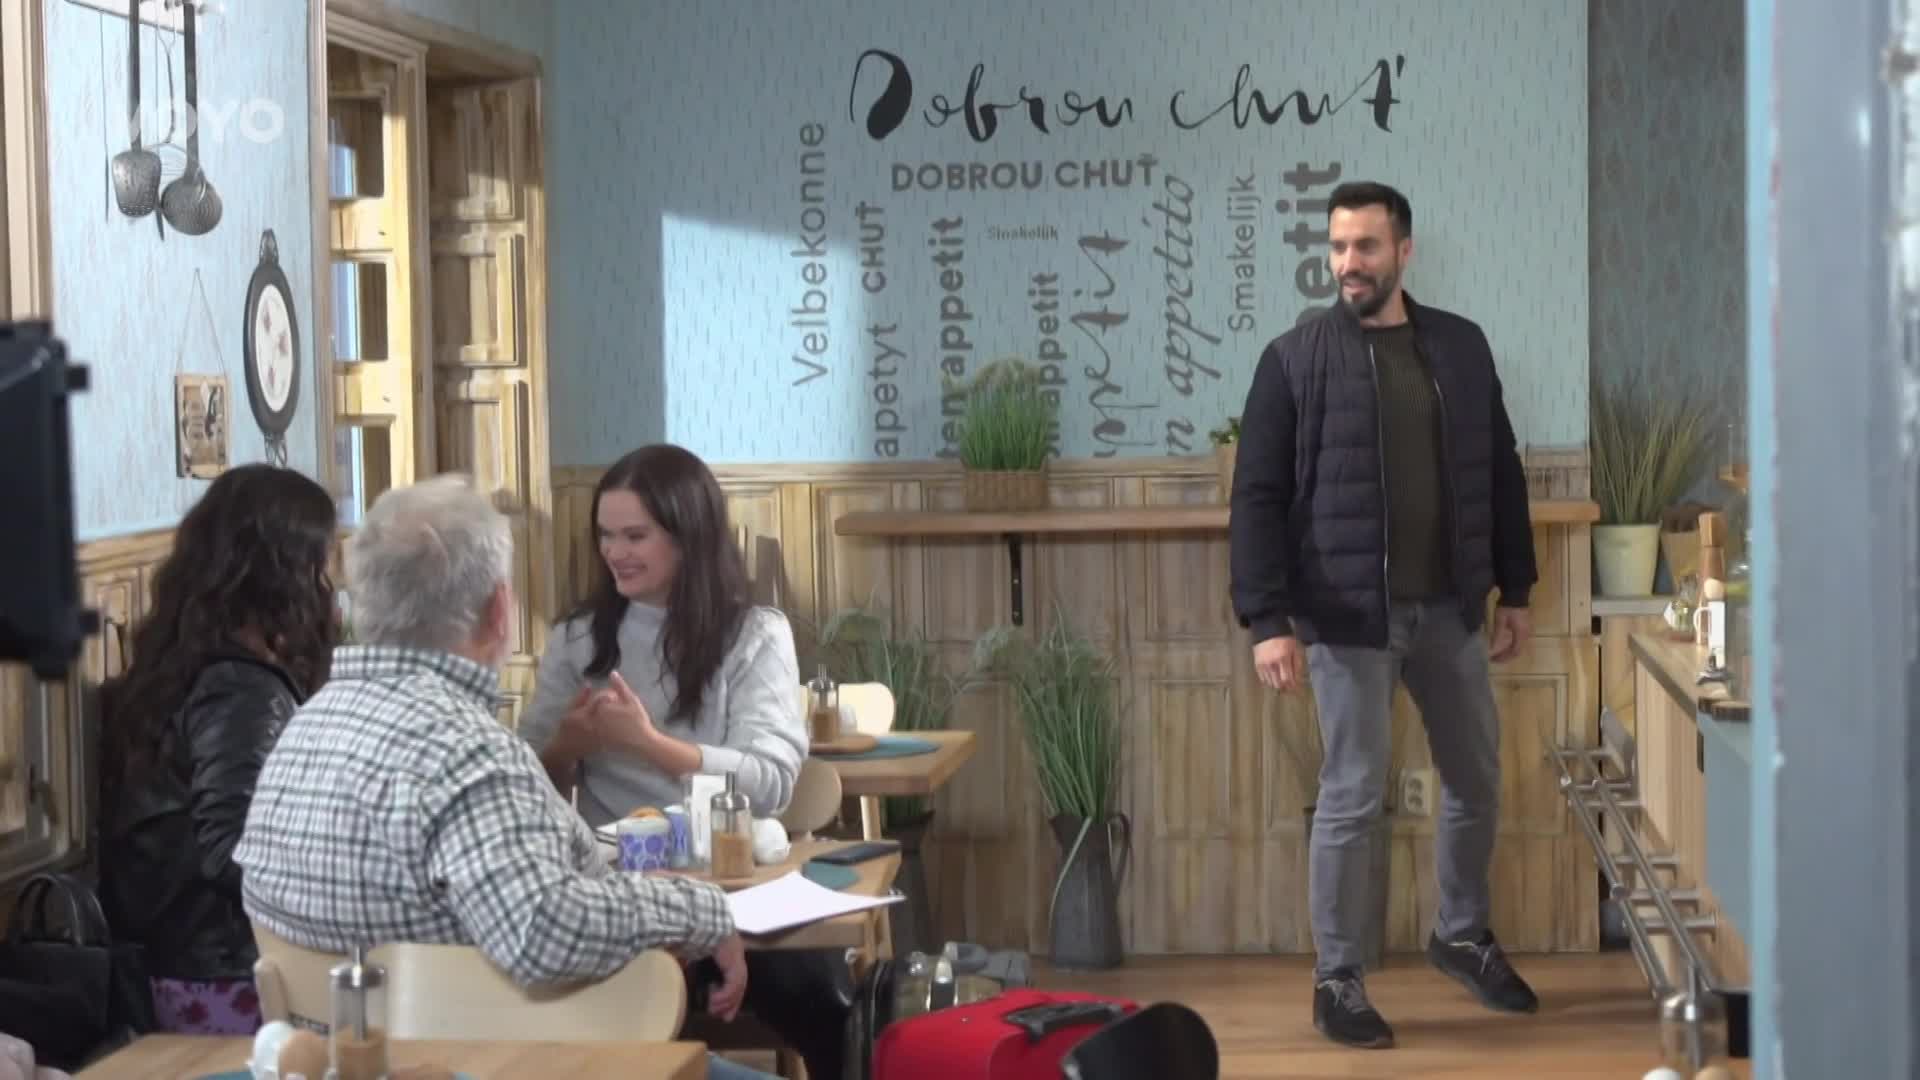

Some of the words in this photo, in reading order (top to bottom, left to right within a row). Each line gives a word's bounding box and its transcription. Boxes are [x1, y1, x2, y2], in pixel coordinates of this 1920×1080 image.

[849, 48, 1134, 142] Dobrou
[890, 161, 1043, 192] DOBROU
[789, 122, 829, 387] Velbekonne
[927, 215, 975, 377] appetit
[1141, 173, 1223, 396] appetito
[1225, 172, 1262, 333] Smakelijk
[866, 322, 909, 458] apetyt
[1027, 271, 1068, 406] appetit
